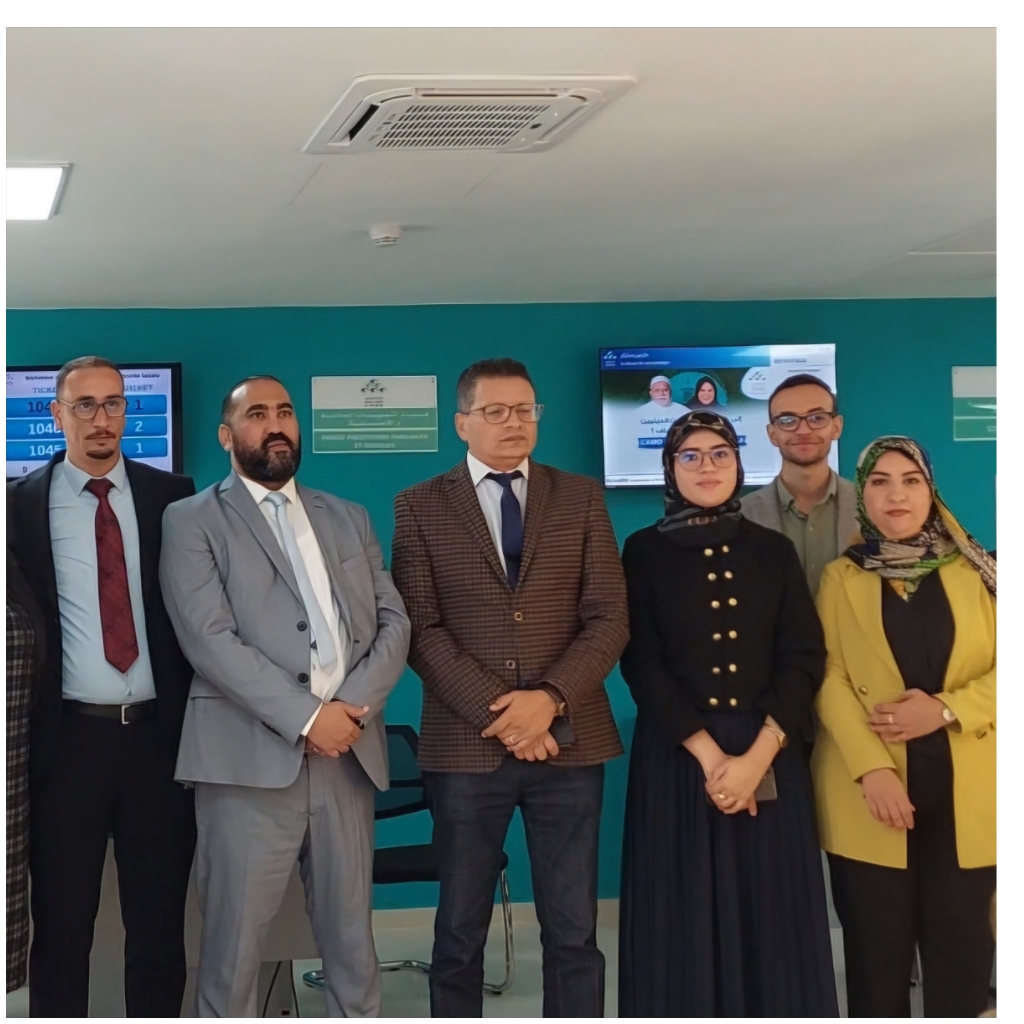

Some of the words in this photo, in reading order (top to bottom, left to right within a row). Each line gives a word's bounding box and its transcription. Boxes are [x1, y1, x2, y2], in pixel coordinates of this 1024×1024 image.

[28, 401, 52, 413] 104
[135, 400, 144, 410] 1
[134, 421, 144, 432] 2
[136, 442, 144, 454] 1
